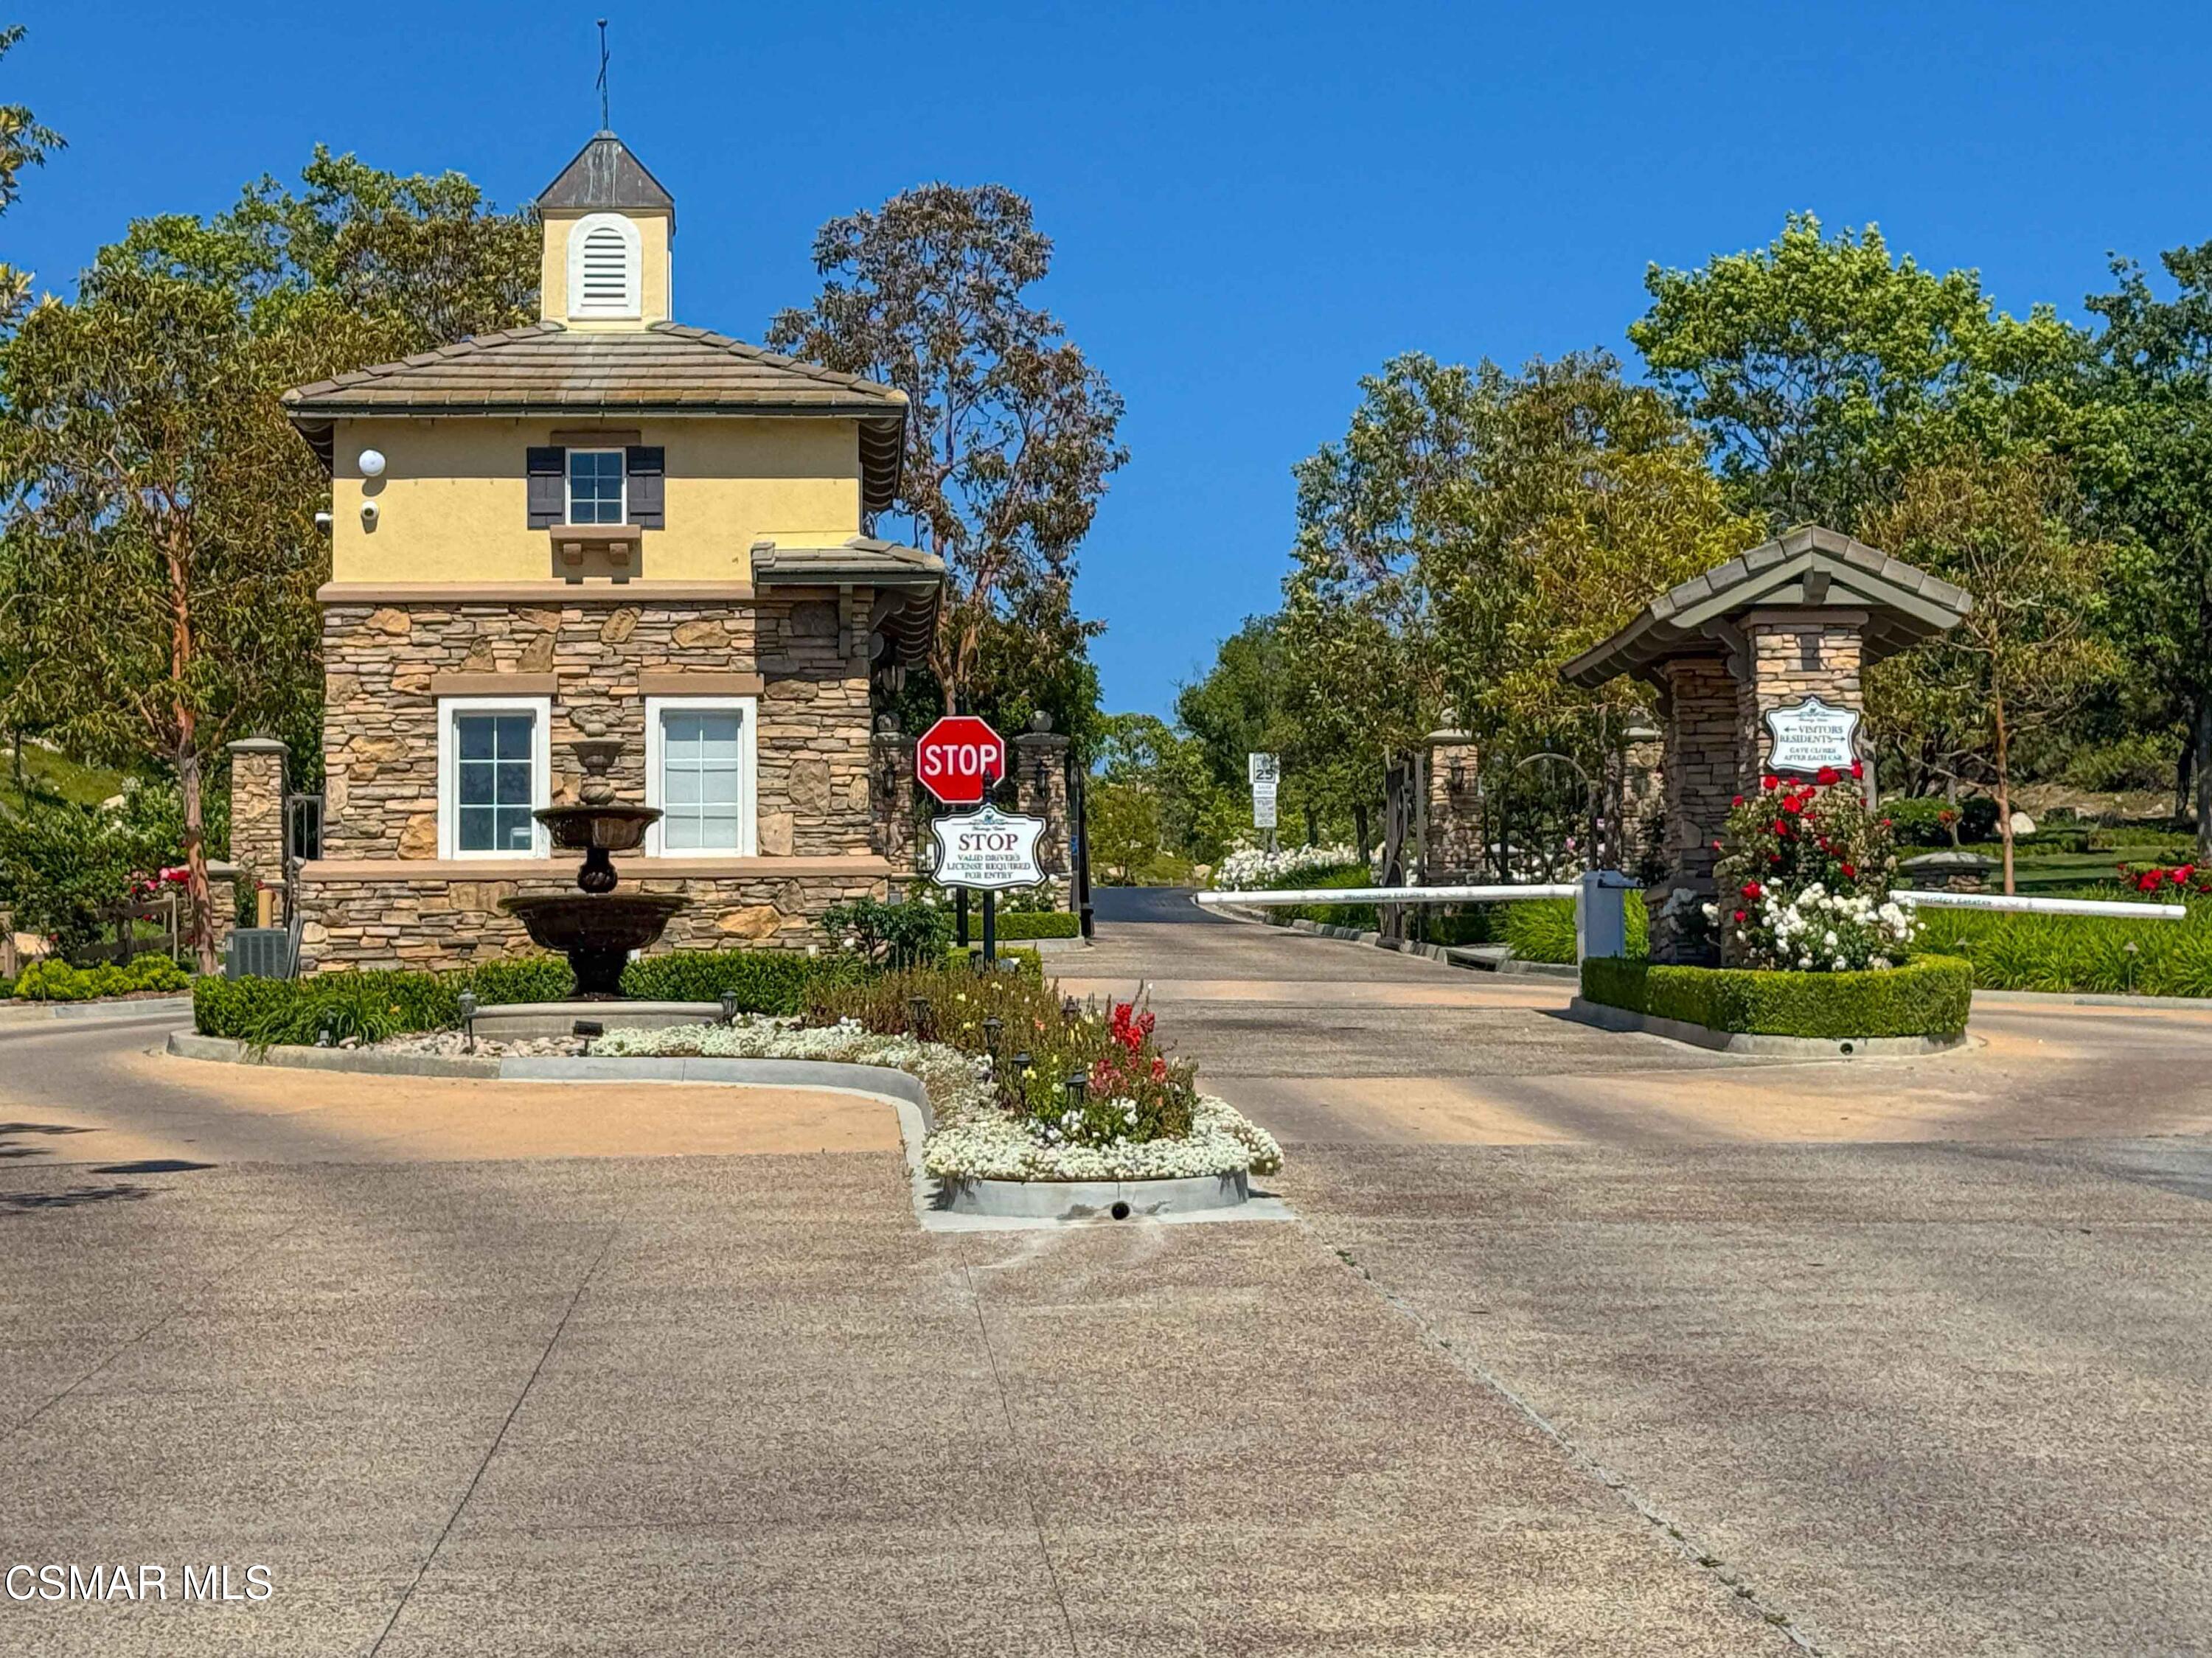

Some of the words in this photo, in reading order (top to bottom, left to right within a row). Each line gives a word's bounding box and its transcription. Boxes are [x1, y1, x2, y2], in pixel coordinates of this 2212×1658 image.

[1799, 725, 1843, 734] VISITORS
[1779, 734, 1833, 743] RESIDENTS
[924, 744, 998, 776] STOP
[1256, 769, 1274, 780] 25
[959, 834, 1019, 851] STOP
[985, 863, 1031, 871] REQUIRED
